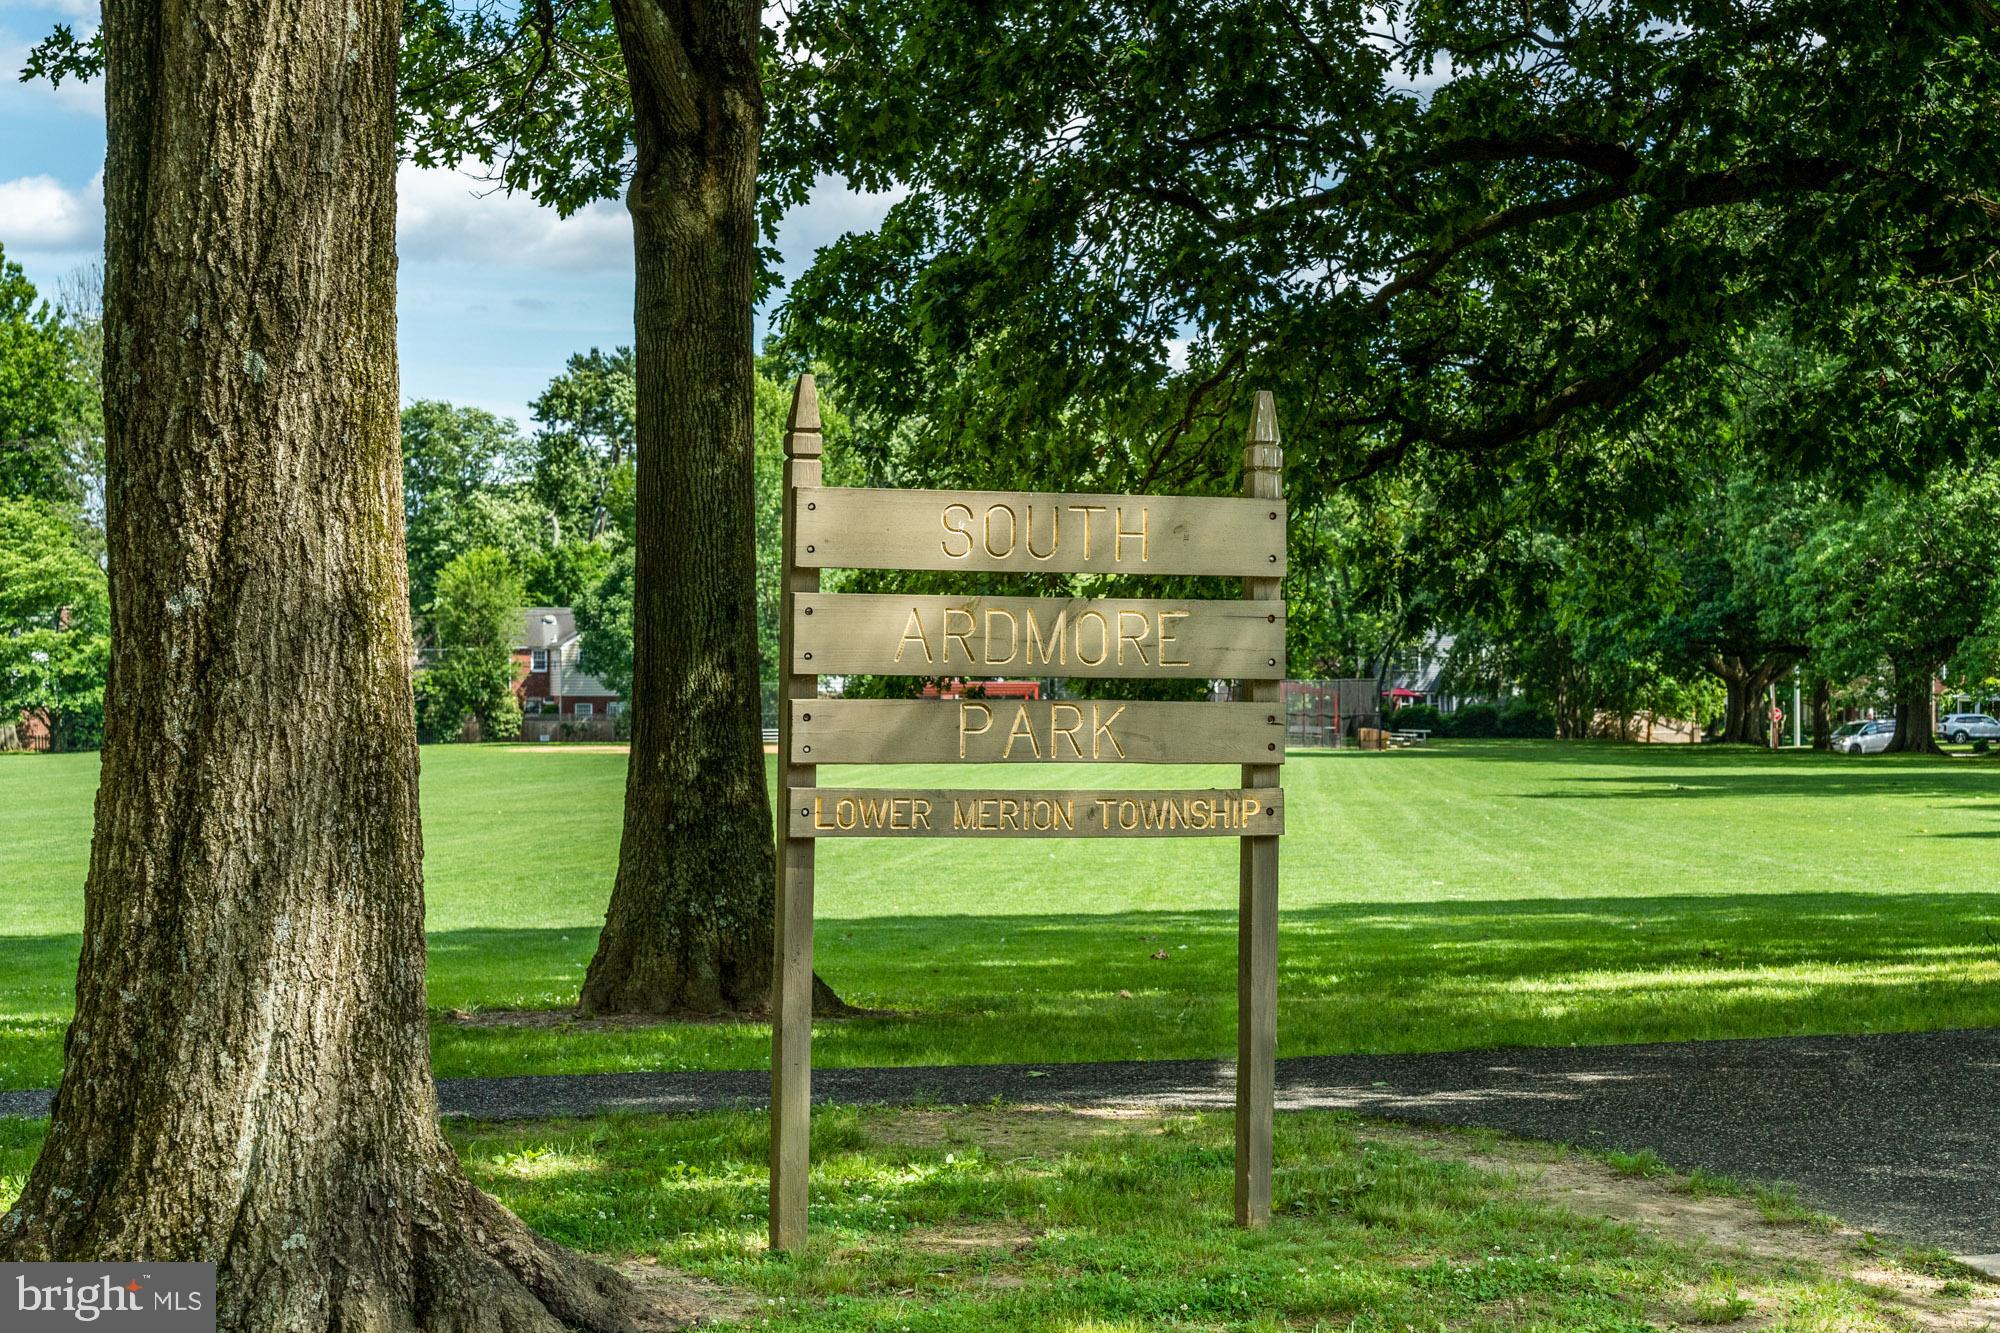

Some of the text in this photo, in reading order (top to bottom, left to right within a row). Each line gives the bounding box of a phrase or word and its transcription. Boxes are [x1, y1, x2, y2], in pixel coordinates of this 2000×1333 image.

[940, 503, 1149, 561] SOUTH
[894, 607, 1192, 667] ARDMORE
[958, 702, 1127, 760] PARK
[814, 796, 1261, 831] LOWER MERION TOWNSHIP
